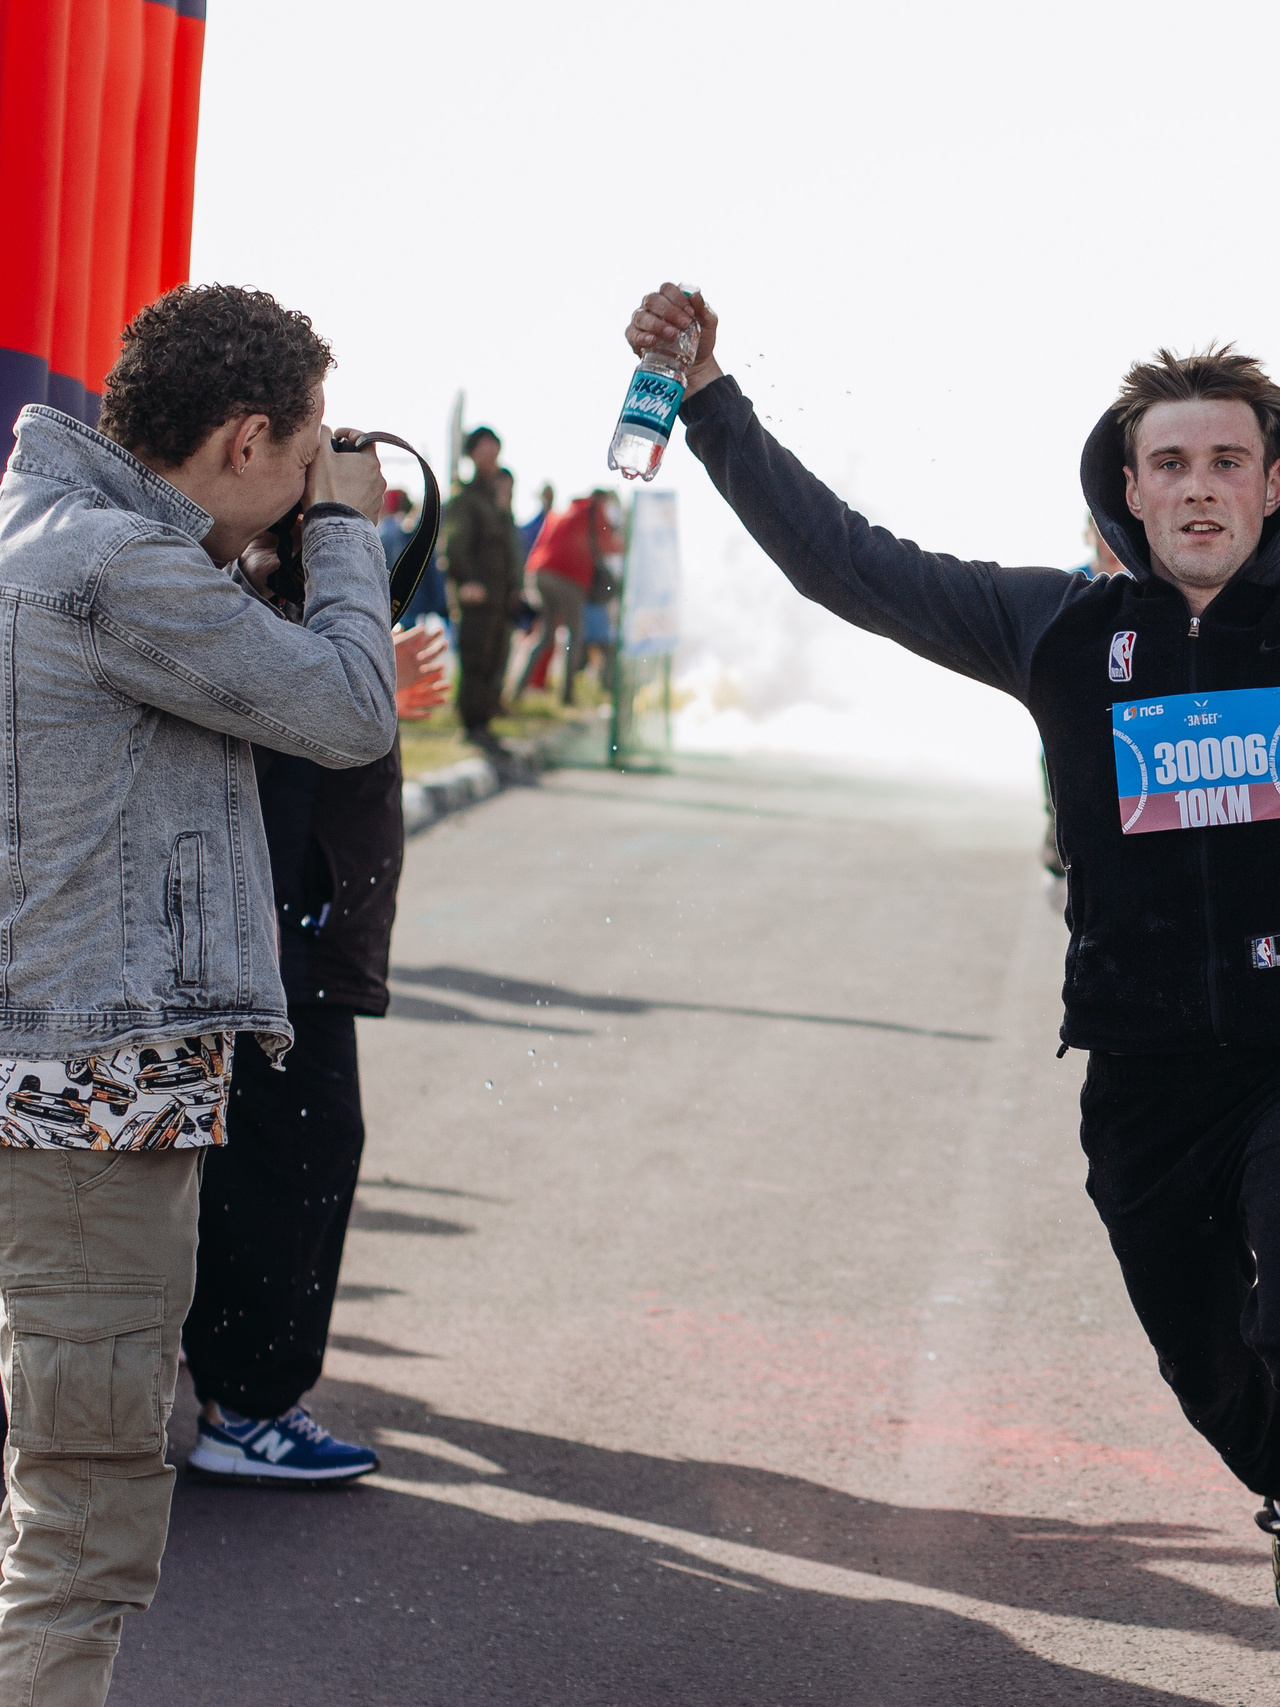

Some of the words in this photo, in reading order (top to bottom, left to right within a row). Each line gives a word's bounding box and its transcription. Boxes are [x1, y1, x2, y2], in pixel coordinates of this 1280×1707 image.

[631, 378, 679, 403] АКВА
[1139, 704, 1164, 718] ПСБ
[1154, 733, 1269, 785] 30006
